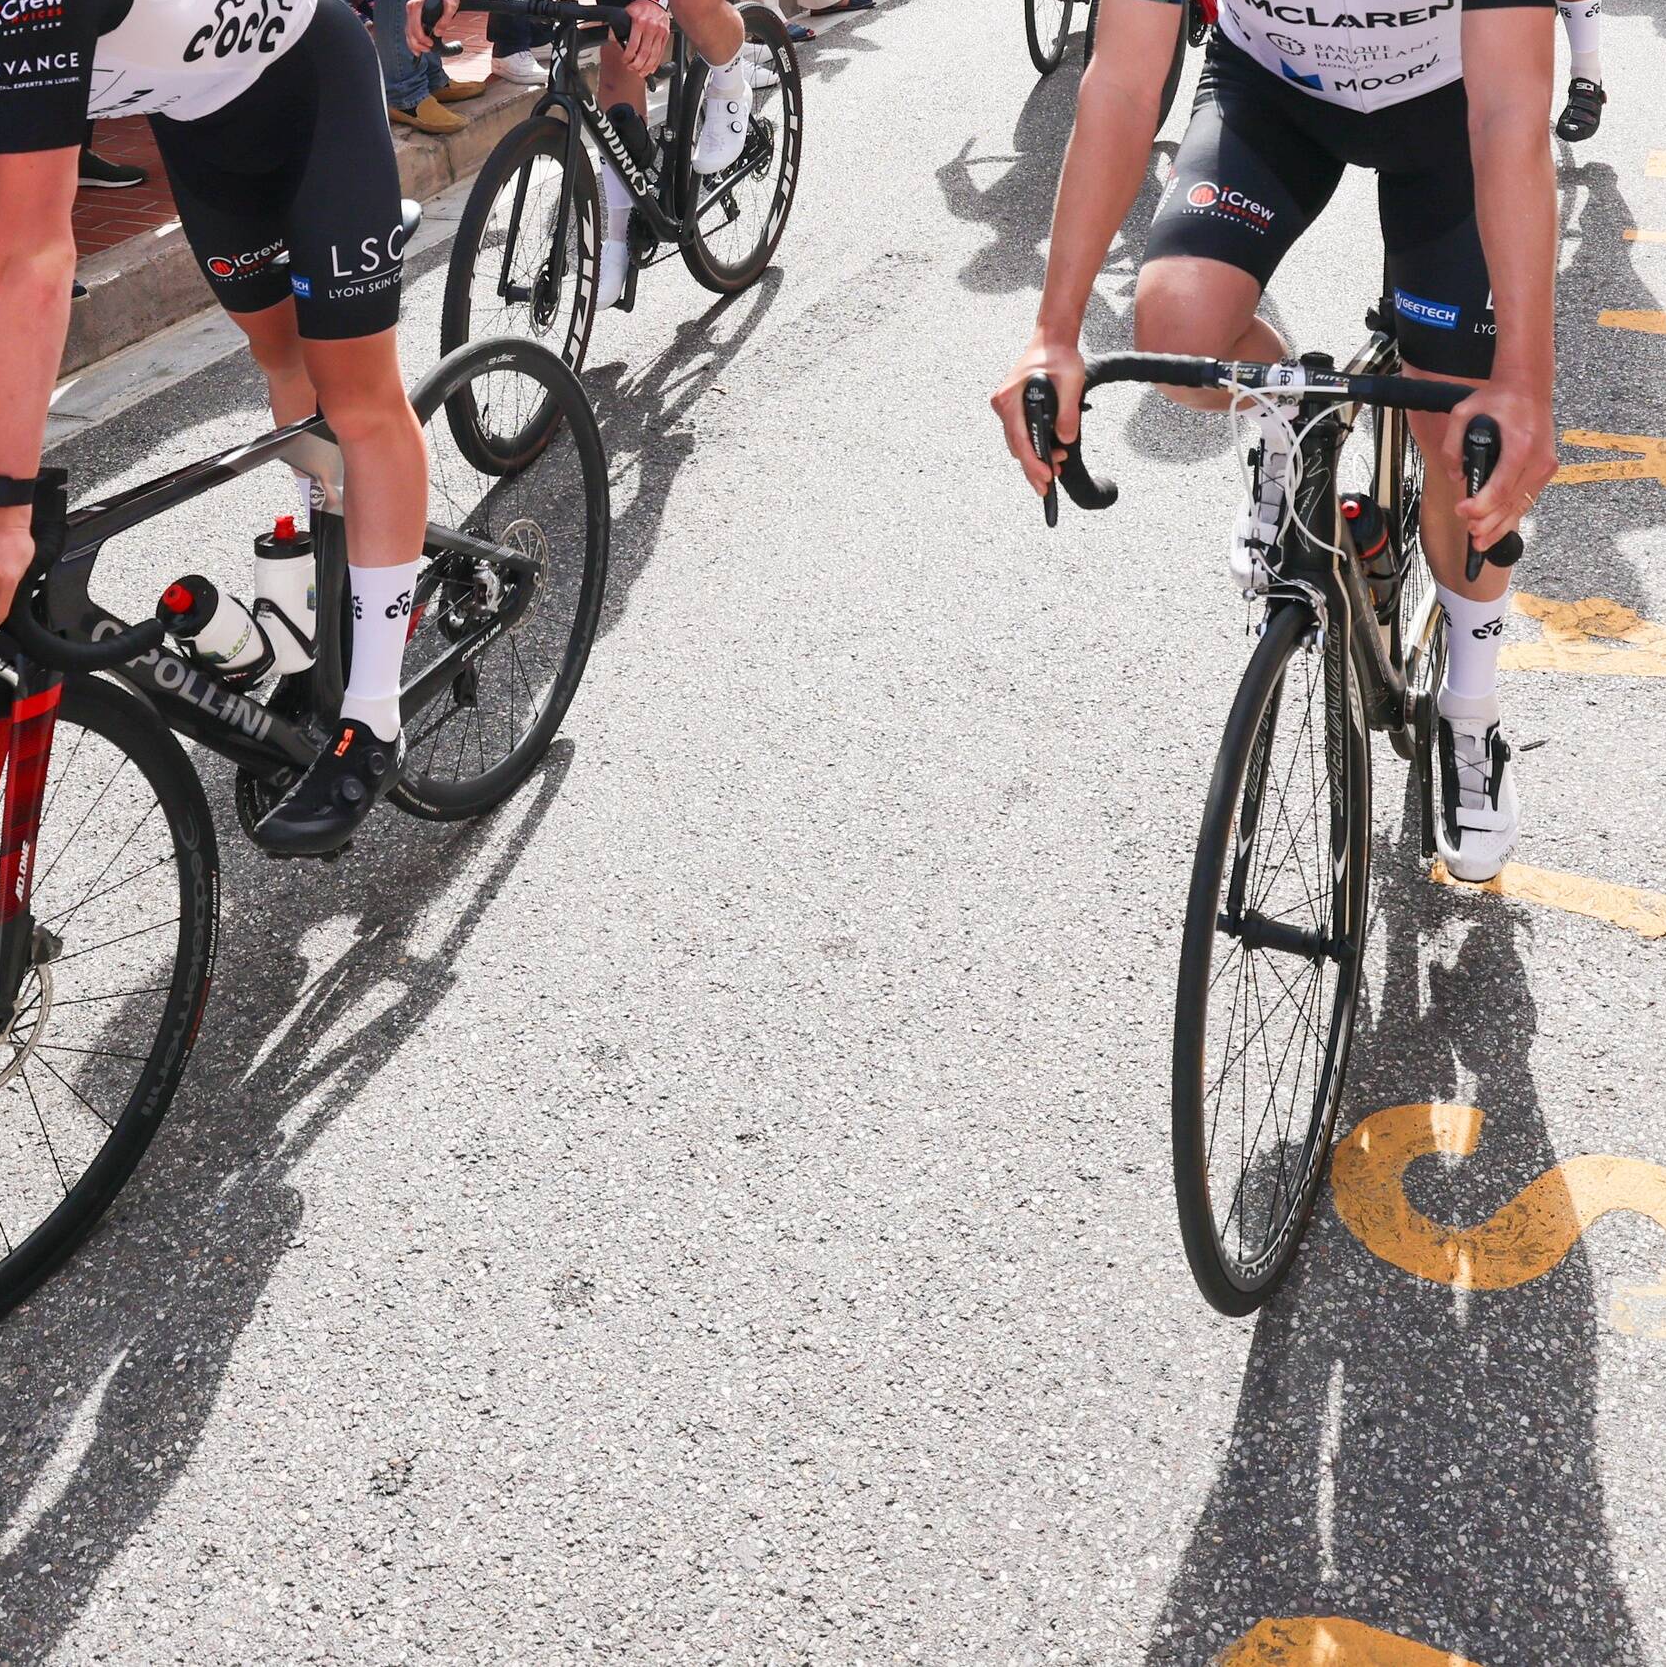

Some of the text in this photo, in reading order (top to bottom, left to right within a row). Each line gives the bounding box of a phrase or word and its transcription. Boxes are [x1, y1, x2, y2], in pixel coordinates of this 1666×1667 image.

[183, 12, 286, 64] COCC
[1221, 186, 1275, 222] iCrew
[331, 224, 405, 278] LSC
[328, 286, 364, 300] LYON
[367, 278, 392, 294] SKIN
[1401, 298, 1456, 322] GEETECH
[461, 622, 502, 663] CIPOLLINI
[91, 619, 274, 743] OLLINI
